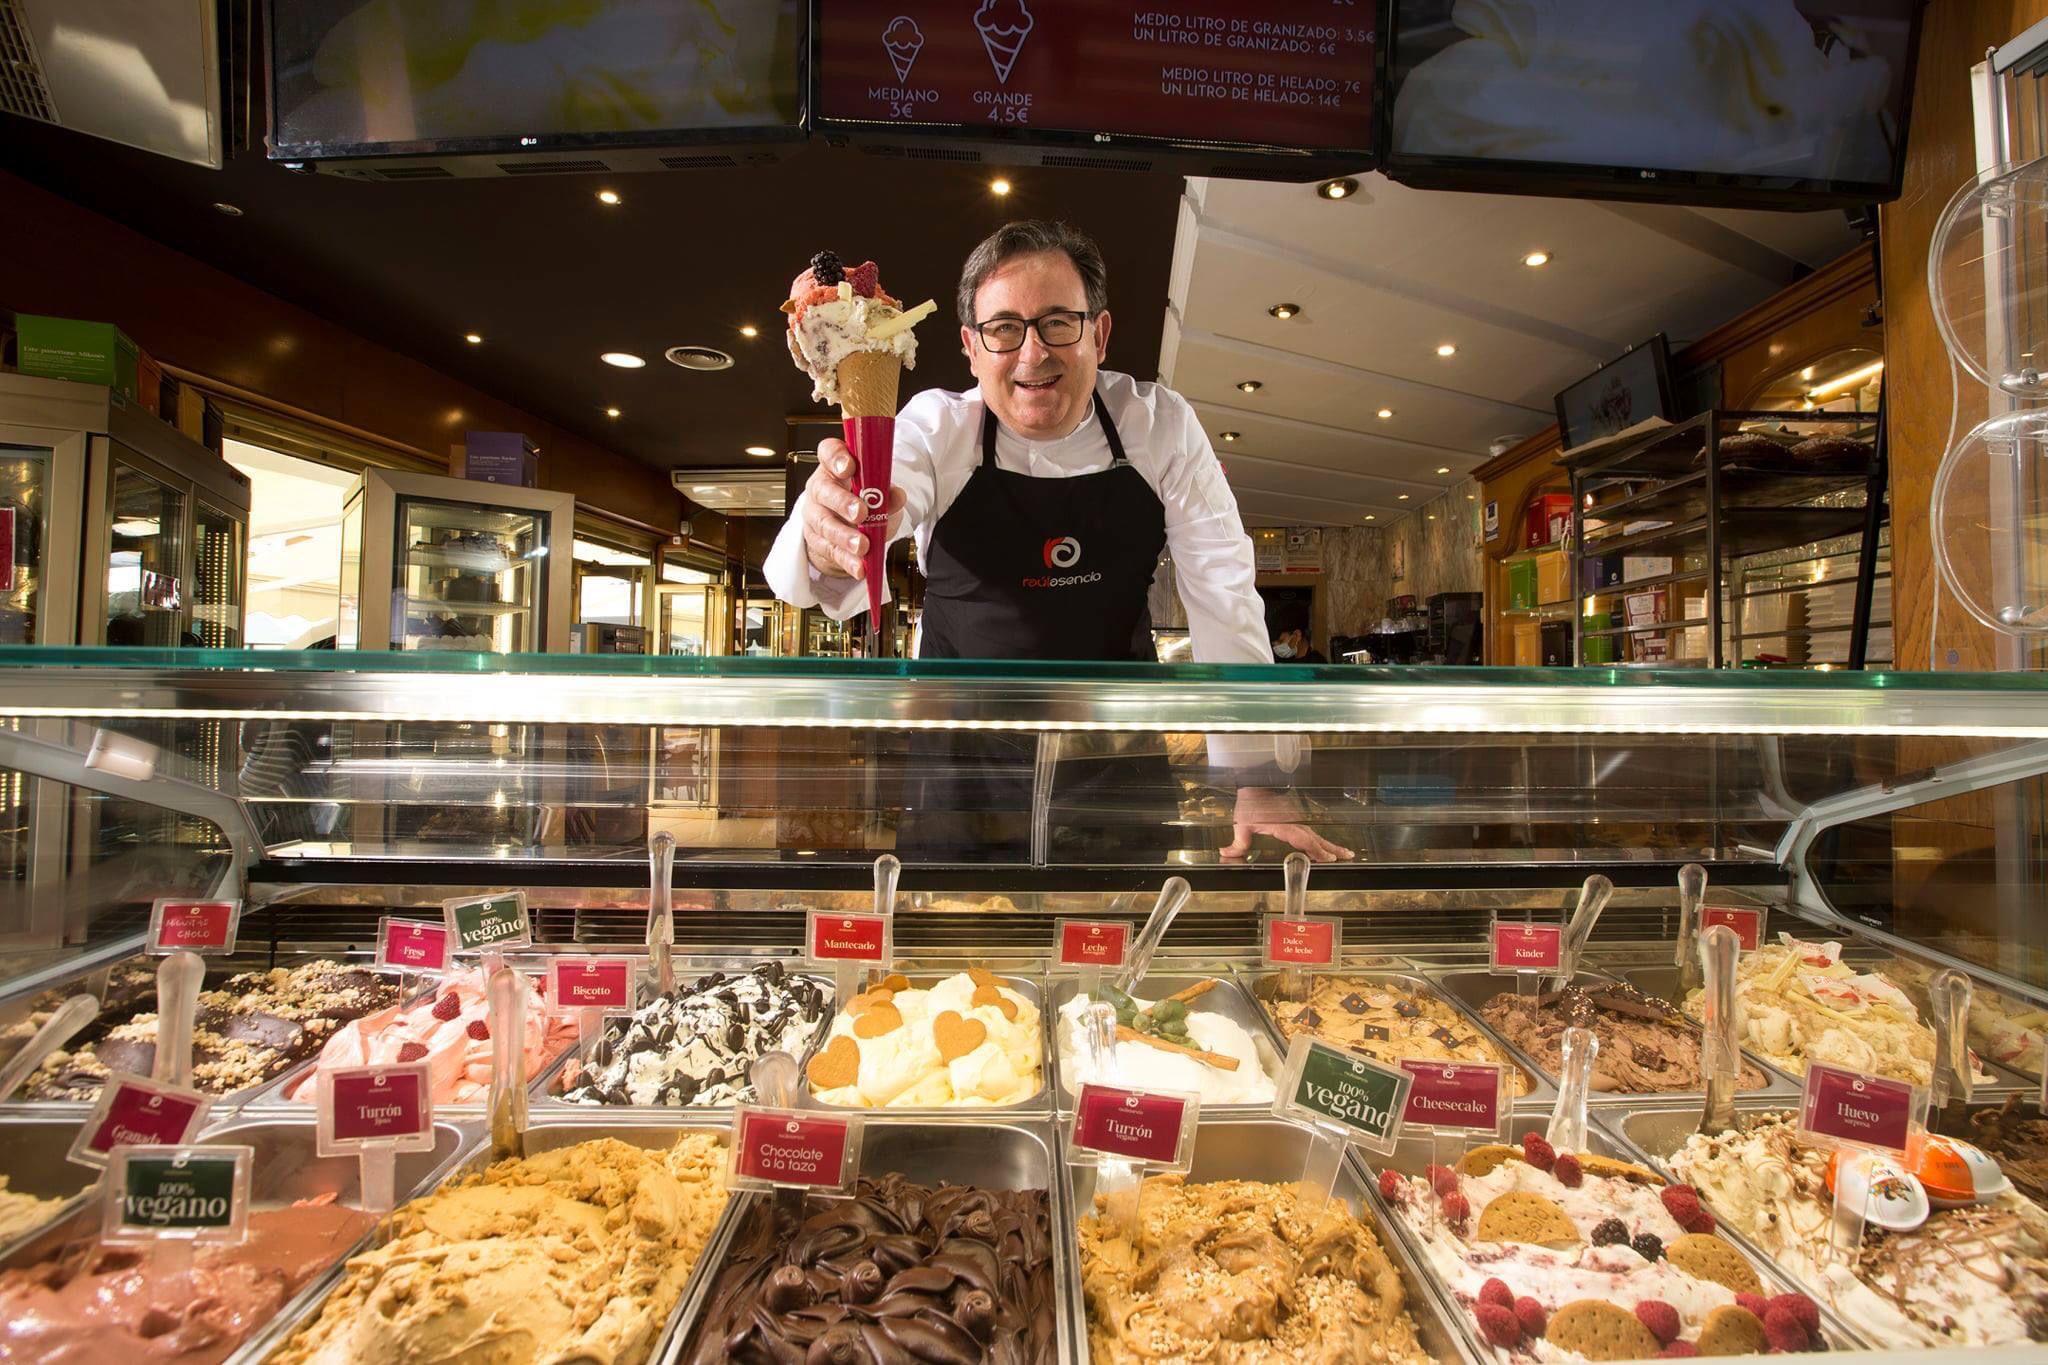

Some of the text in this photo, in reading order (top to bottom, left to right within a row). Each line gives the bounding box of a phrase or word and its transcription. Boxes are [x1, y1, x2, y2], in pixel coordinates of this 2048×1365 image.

[1134, 12, 1376, 44] MEDIO LITRO DE GRANIZADO: 3,5€
[1133, 28, 1336, 55] UN LITRO DE GRANIZADO: 6€
[1162, 67, 1361, 94] MEDIO LITRO DE HELADO: 7€
[868, 87, 939, 102] MEDIANO
[973, 91, 1033, 106] GRANDE
[1161, 82, 1342, 107] UN LITRO DE HELADO: 14€
[889, 102, 913, 119] 3€
[987, 106, 1029, 123] 4,5€
[480, 916, 503, 928] 100%
[462, 918, 525, 944] vegano
[824, 939, 876, 951] Mantecado
[1082, 942, 1108, 952] Leche
[1283, 937, 1304, 945] Dulce
[403, 946, 426, 957] Fresa
[1295, 946, 1313, 954] leche
[1515, 948, 1545, 958] Kinder
[573, 985, 611, 996] Biscotto
[1338, 1081, 1369, 1103] 100%
[357, 1103, 403, 1120] Turrón
[1305, 1080, 1392, 1129] vegano
[1412, 1095, 1488, 1113] Cheesecake
[1837, 1102, 1880, 1123] Huevo
[1106, 1118, 1153, 1139] Turrón
[760, 1143, 824, 1161] Chocolate
[761, 1158, 816, 1173] a la taza
[157, 1182, 196, 1197] 100%
[125, 1195, 228, 1225] vegano
